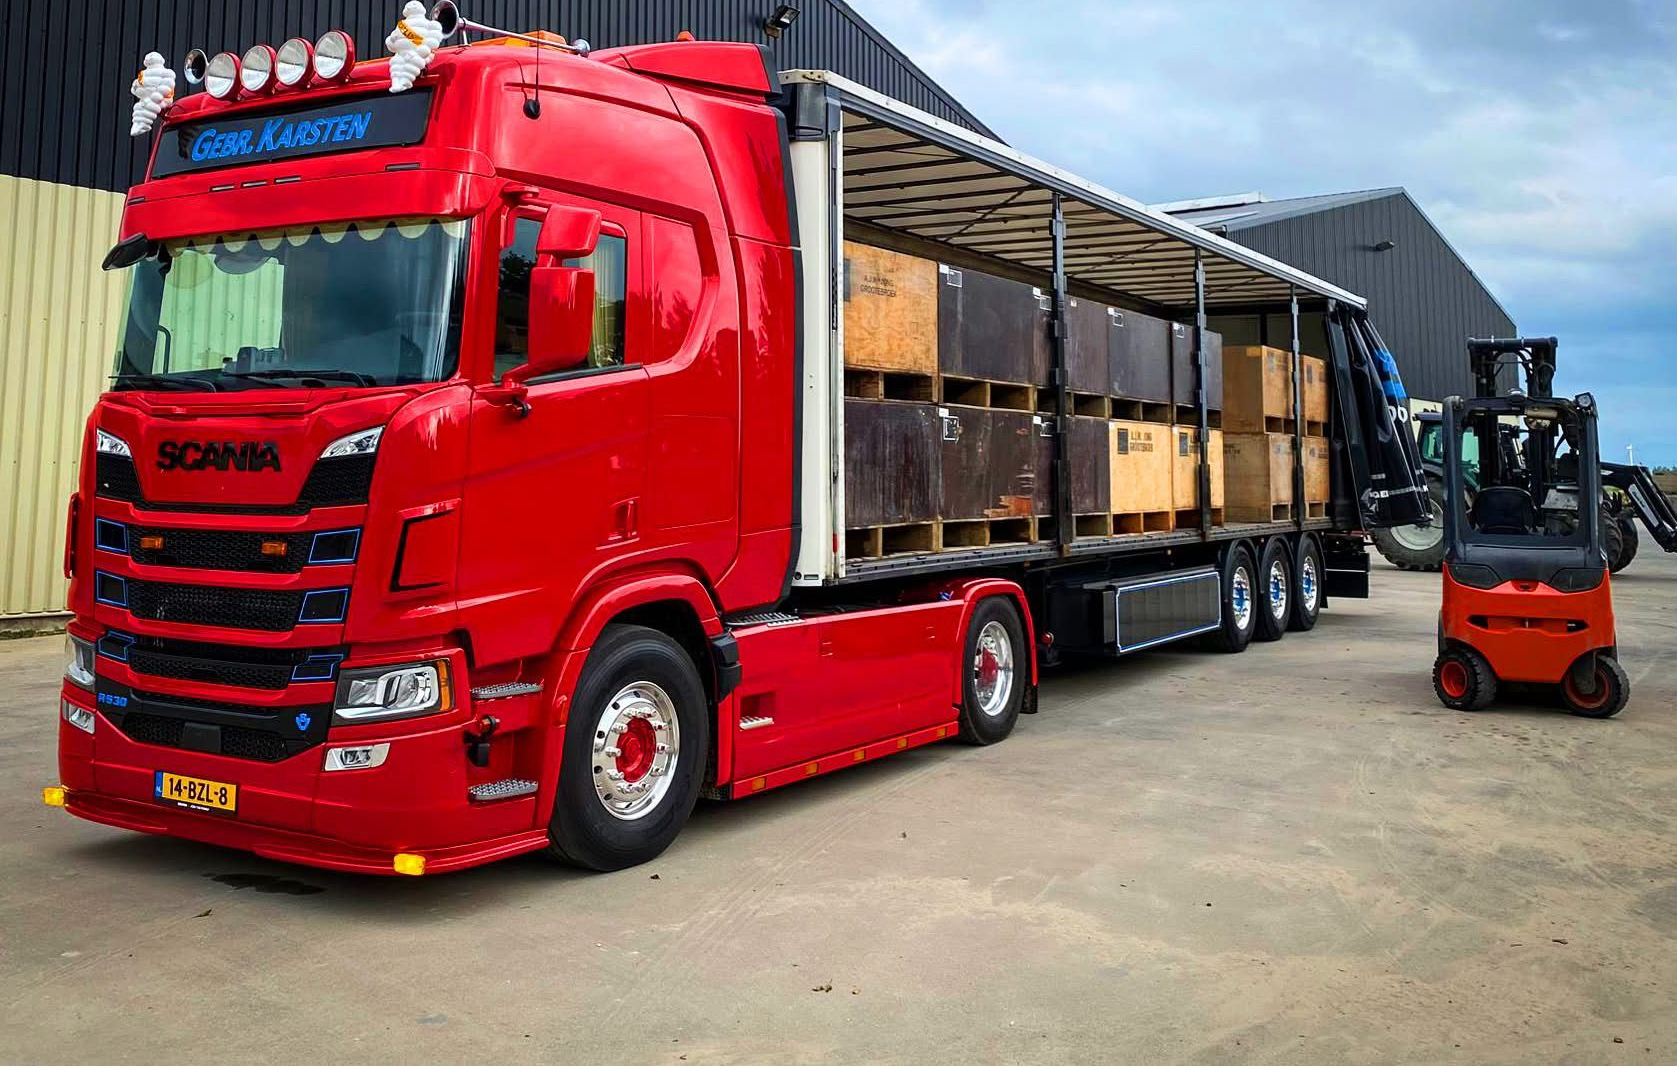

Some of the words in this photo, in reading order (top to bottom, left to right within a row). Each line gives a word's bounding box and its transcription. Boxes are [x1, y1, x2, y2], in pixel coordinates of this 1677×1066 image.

[192, 128, 253, 162] GEBR.
[256, 111, 372, 153] KARSTEN
[156, 440, 282, 473] SCANIA
[98, 692, 128, 708] R530
[169, 777, 228, 806] 14-BZL-8
